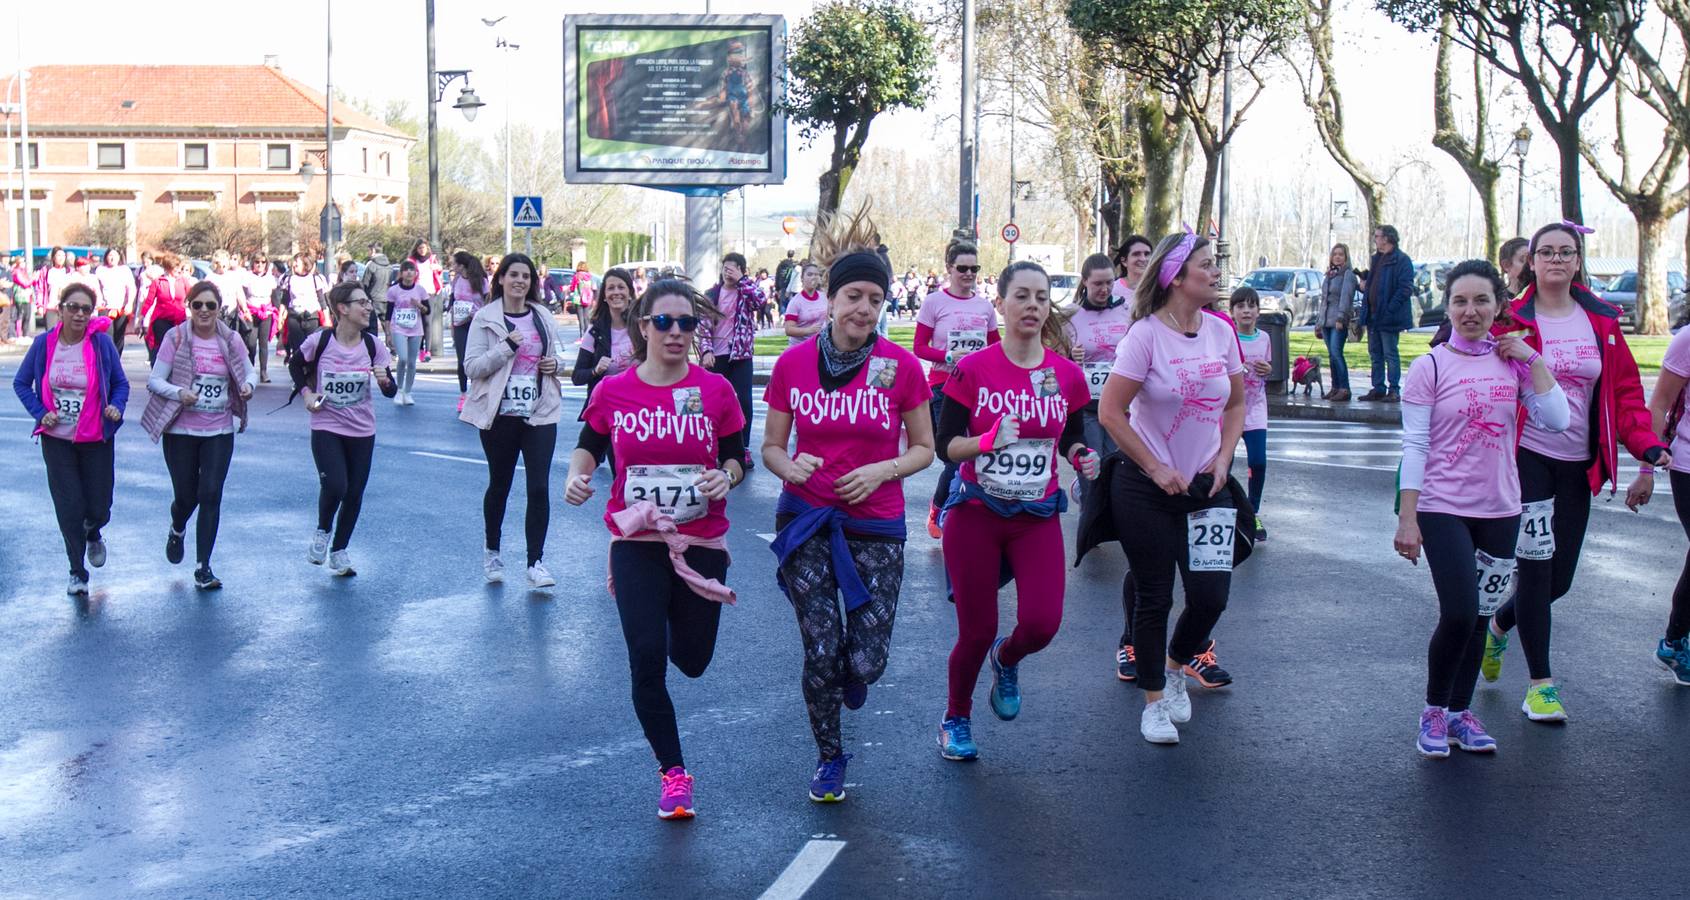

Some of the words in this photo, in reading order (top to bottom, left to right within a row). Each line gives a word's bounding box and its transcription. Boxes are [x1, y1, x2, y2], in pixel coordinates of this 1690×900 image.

[586, 40, 640, 53] TEATRO
[652, 157, 684, 165] PARQUE
[687, 157, 711, 165] RIOJA
[1006, 229, 1017, 237] 30
[396, 313, 417, 321] 2749
[195, 382, 222, 398] 789
[324, 381, 364, 395] 4807
[981, 452, 1047, 477] 2999
[632, 485, 701, 508] 3171
[1524, 515, 1551, 539] 41
[1193, 524, 1235, 546] 287
